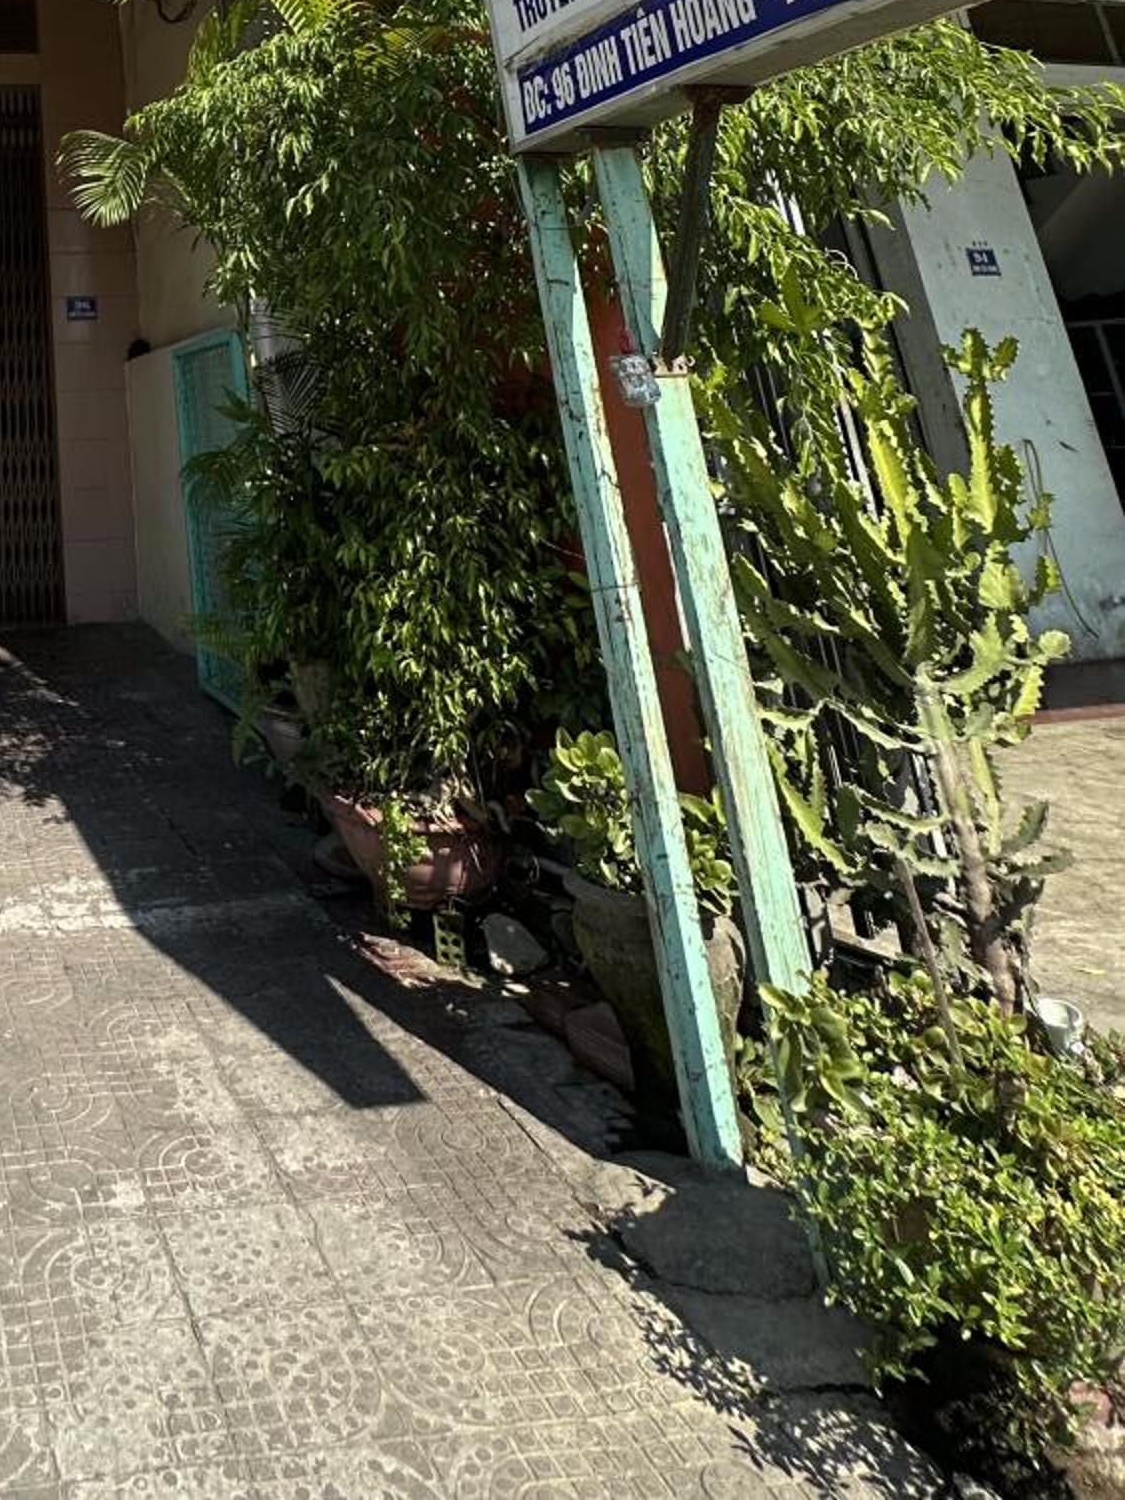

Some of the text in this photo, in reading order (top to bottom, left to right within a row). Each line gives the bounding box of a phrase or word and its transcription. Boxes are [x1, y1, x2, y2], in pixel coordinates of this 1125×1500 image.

[522, 74, 553, 126] ĐC:
[551, 61, 576, 111] 96
[574, 35, 623, 100] ĐINH
[620, 7, 673, 76] TIÊN
